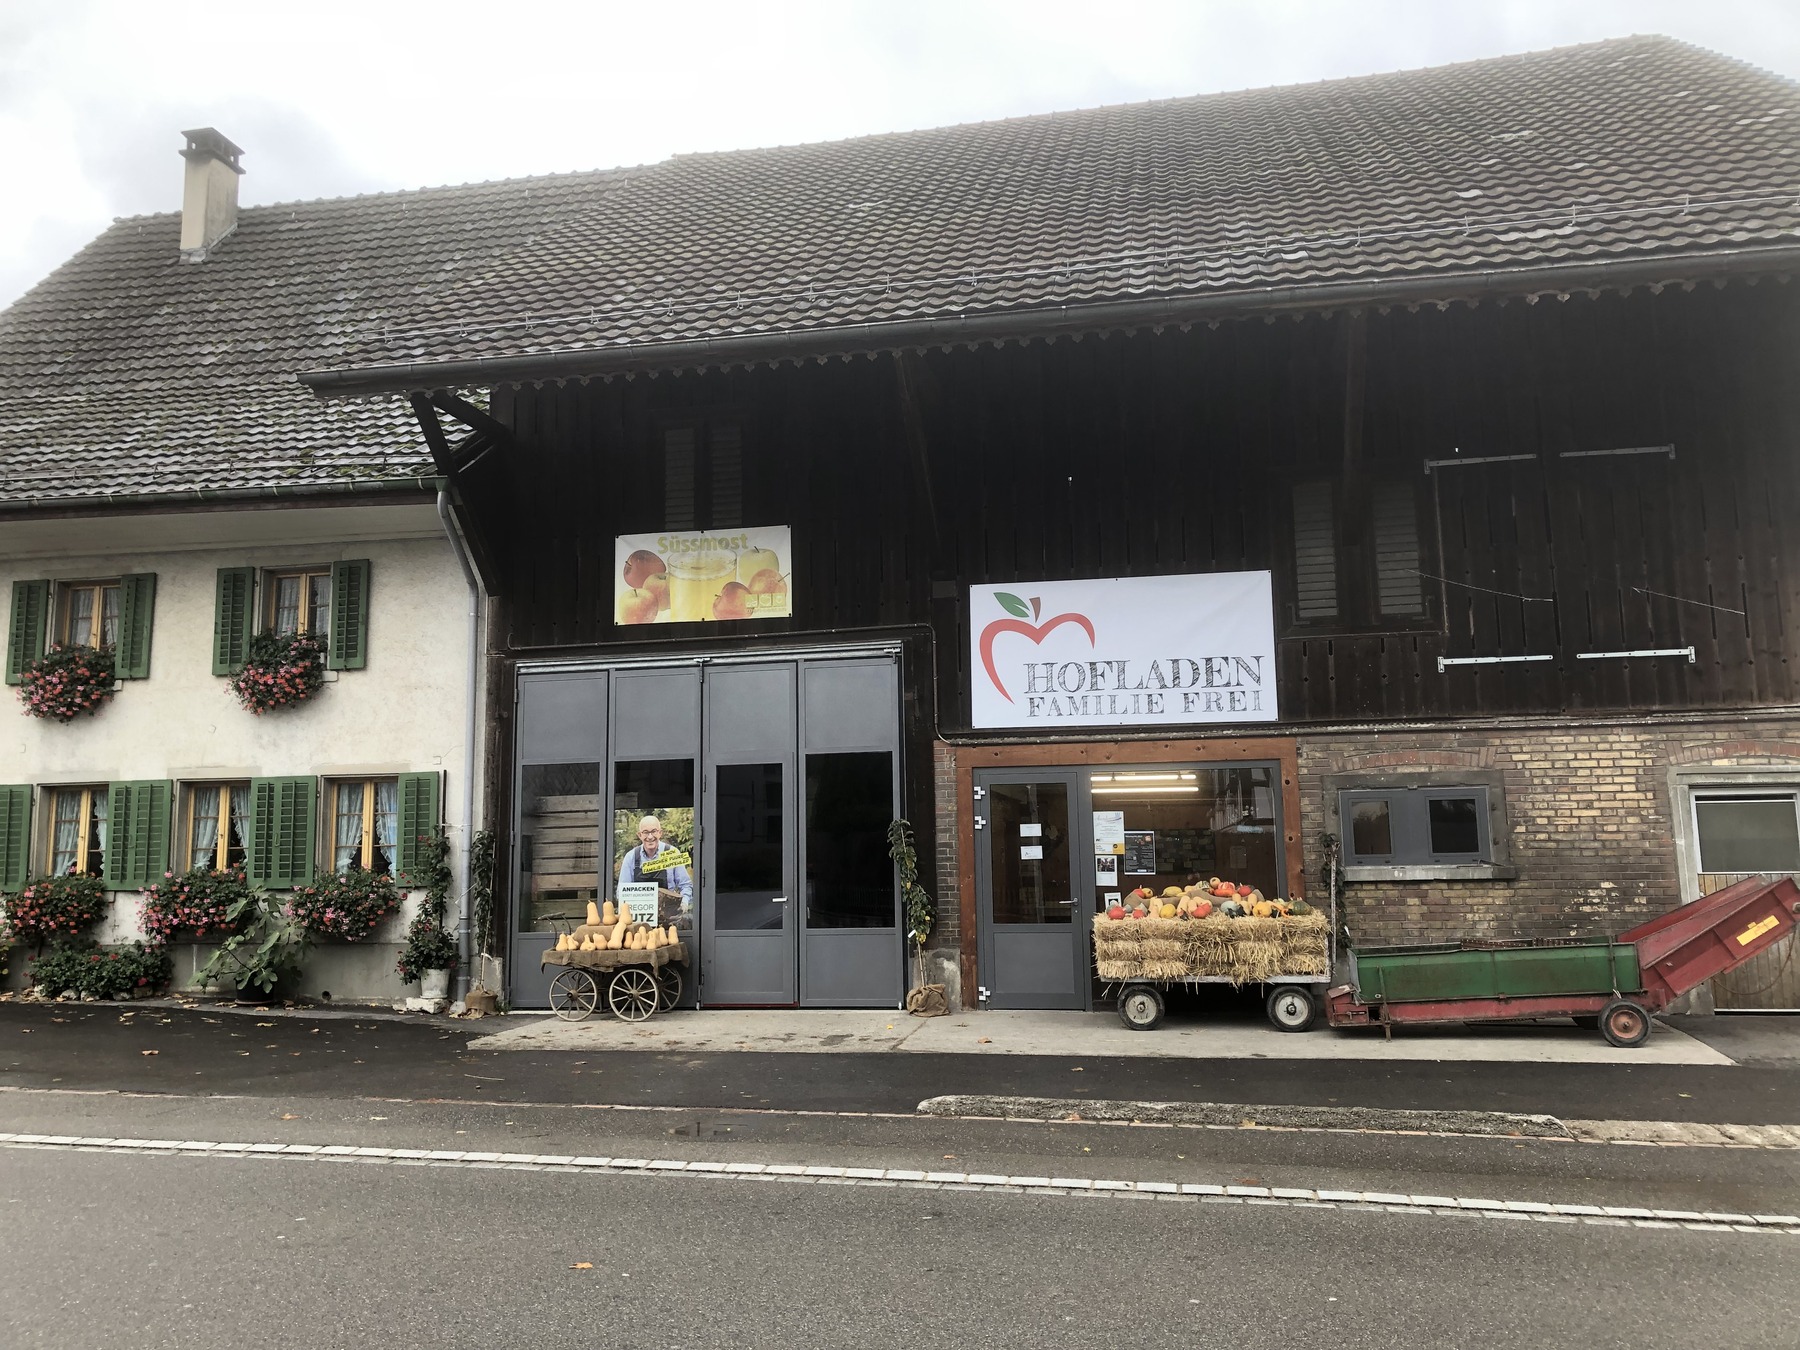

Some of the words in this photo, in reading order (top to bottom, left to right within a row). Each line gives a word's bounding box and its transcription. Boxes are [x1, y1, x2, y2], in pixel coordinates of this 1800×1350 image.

[657, 533, 749, 554] Süssmost
[1023, 655, 1265, 693] HOFLADEN
[1026, 693, 1165, 717] FAMILIE
[1180, 690, 1264, 713] FREI
[628, 903, 654, 911] REGOR
[631, 912, 654, 922] UTZ
